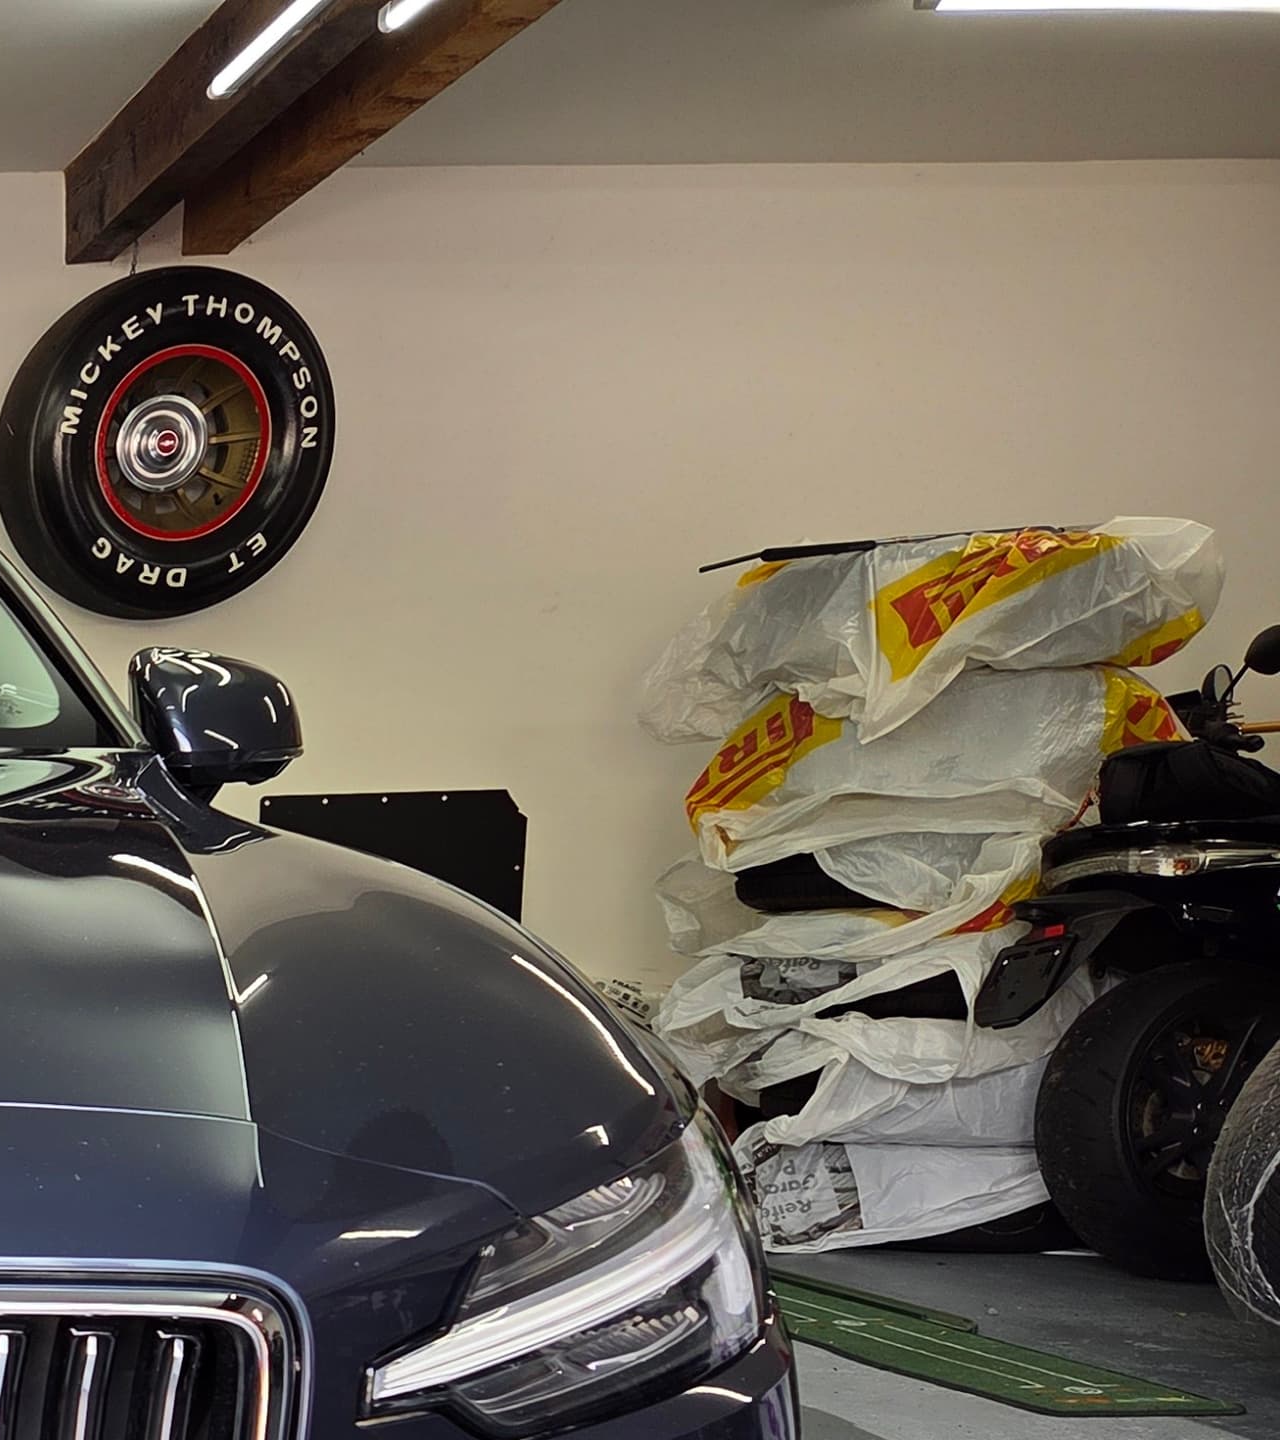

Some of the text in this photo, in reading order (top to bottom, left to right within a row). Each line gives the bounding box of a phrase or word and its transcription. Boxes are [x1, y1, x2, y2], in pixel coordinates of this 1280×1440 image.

[60, 294, 319, 450] MICKEY THOMPSON
[90, 531, 269, 588] ET DRAG
